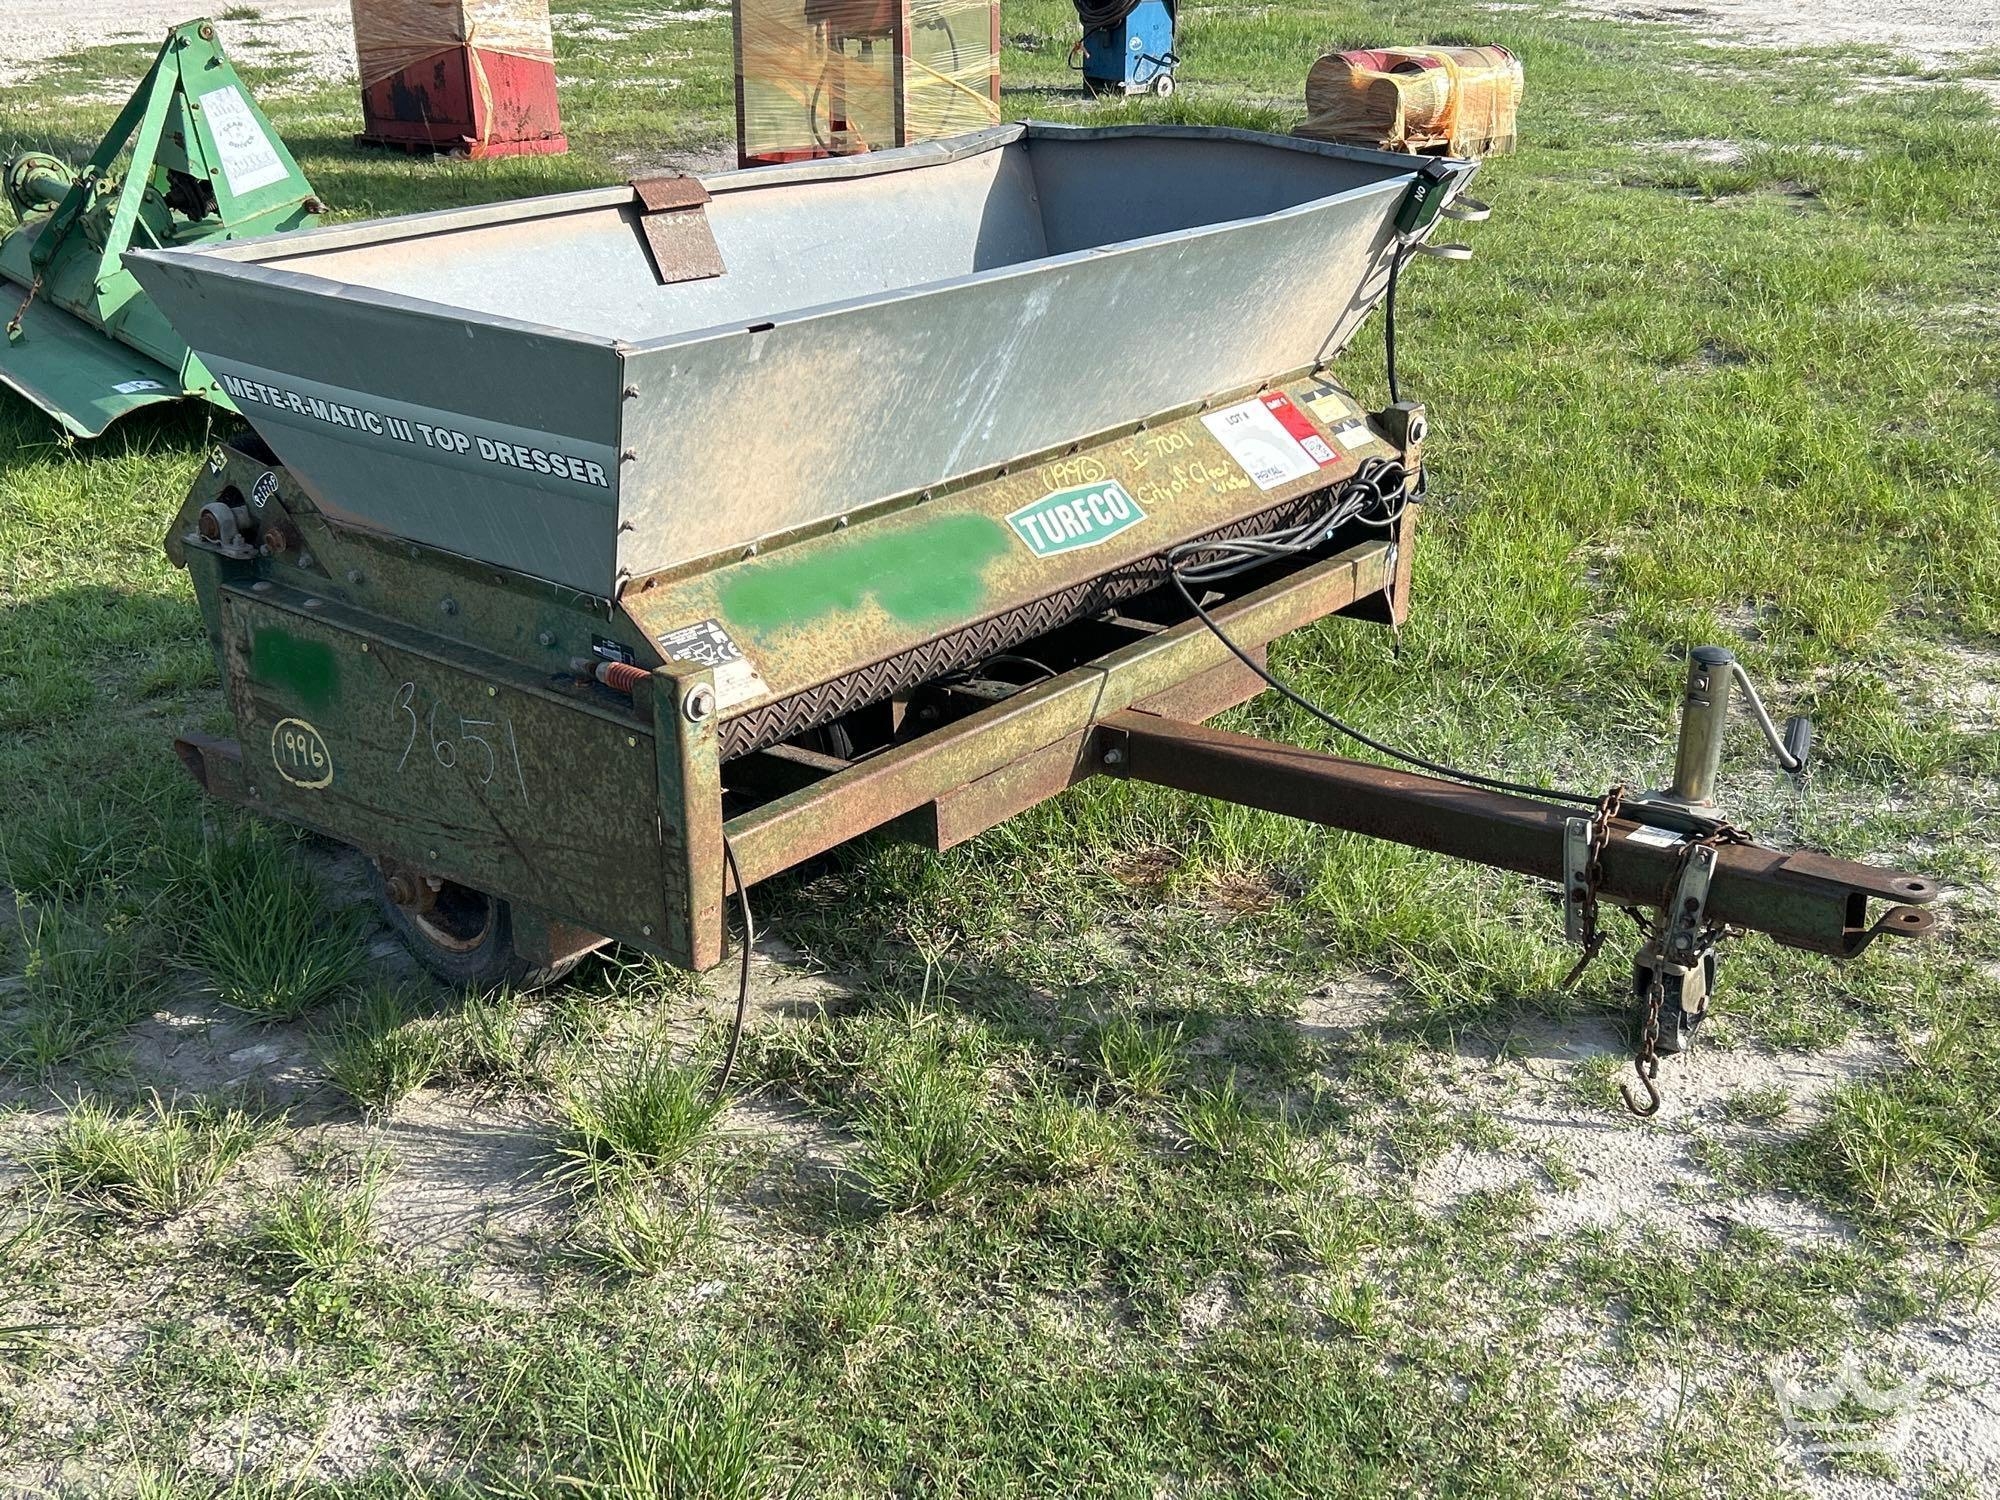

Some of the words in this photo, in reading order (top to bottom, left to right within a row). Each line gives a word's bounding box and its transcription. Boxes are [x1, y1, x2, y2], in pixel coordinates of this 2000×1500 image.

[222, 374, 384, 435] METE-R-MATIC
[385, 416, 415, 443] III
[415, 422, 471, 454] TOP
[475, 435, 610, 488] DRESSER
[1225, 413, 1243, 426] LOT
[1137, 482, 1174, 504] City
[1170, 465, 1190, 493] of
[1018, 487, 1131, 550] TURFCO
[280, 731, 324, 768] 1996
[391, 682, 530, 810] 3651
